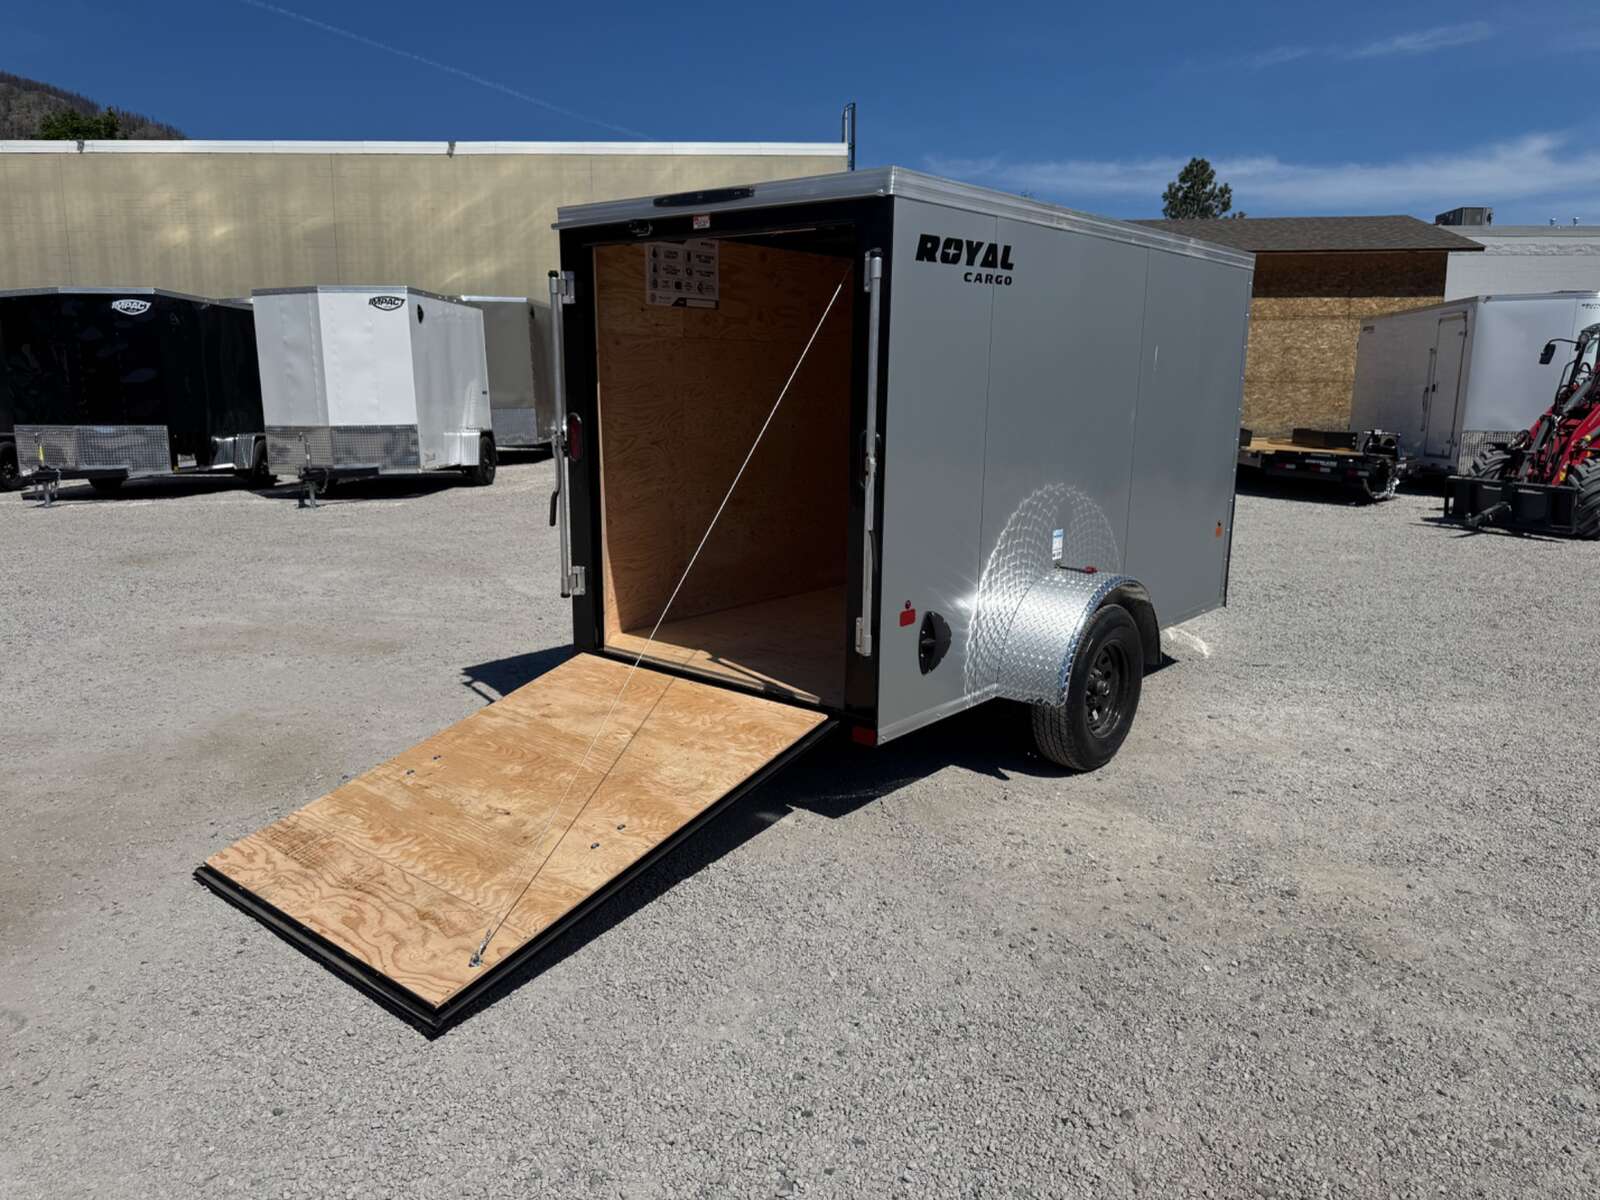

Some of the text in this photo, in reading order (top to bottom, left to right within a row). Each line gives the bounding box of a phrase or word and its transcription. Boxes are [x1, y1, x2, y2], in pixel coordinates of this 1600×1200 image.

[915, 233, 1014, 270] ROYAL
[963, 272, 1013, 286] CARGO
[111, 299, 152, 312] IMPACT
[368, 296, 406, 307] IMPACT
